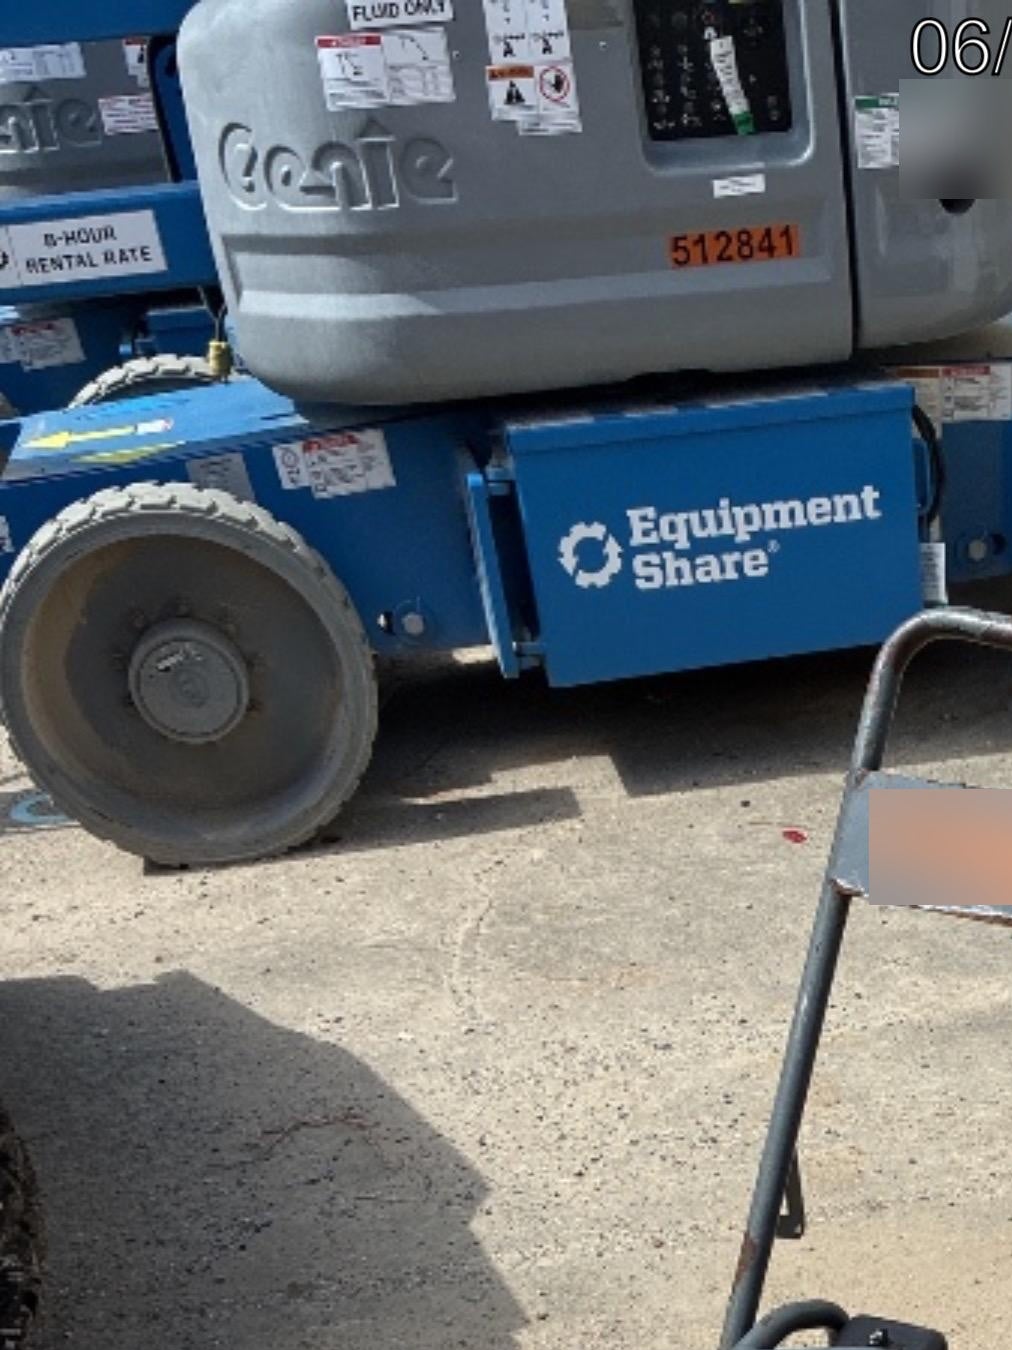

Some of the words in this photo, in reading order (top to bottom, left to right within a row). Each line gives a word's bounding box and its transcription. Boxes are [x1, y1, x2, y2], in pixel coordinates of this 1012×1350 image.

[352, 3, 400, 22] FLUID
[405, 0, 445, 17] ONLY
[218, 115, 460, 211] Genie
[43, 225, 118, 248] 8-HOUR
[671, 224, 794, 266] 512841
[25, 251, 98, 274] RENTAL
[103, 246, 153, 265] RATE
[626, 484, 883, 550] Equipment
